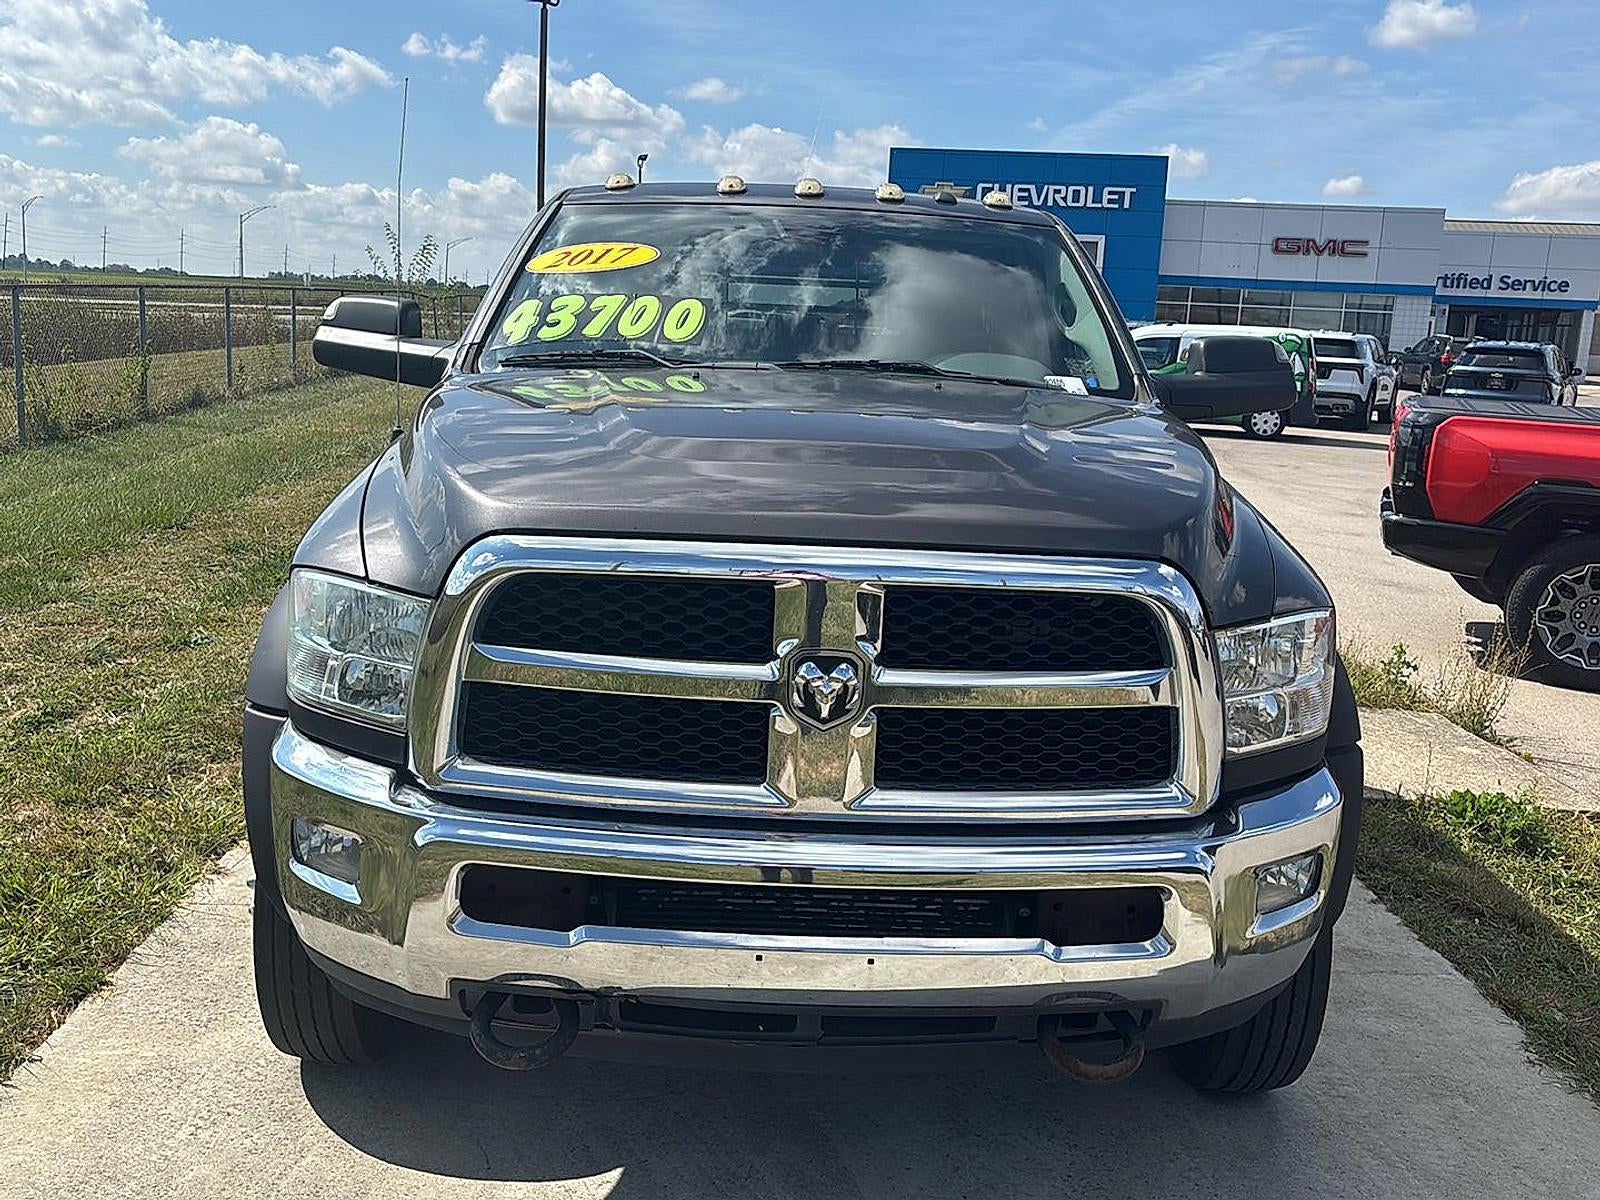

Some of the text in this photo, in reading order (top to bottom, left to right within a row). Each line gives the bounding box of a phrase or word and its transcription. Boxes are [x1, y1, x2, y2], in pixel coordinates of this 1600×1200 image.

[1273, 237, 1369, 257] GMC
[543, 247, 639, 269] 2017
[1498, 274, 1570, 293] Service
[502, 294, 706, 345] 43700
